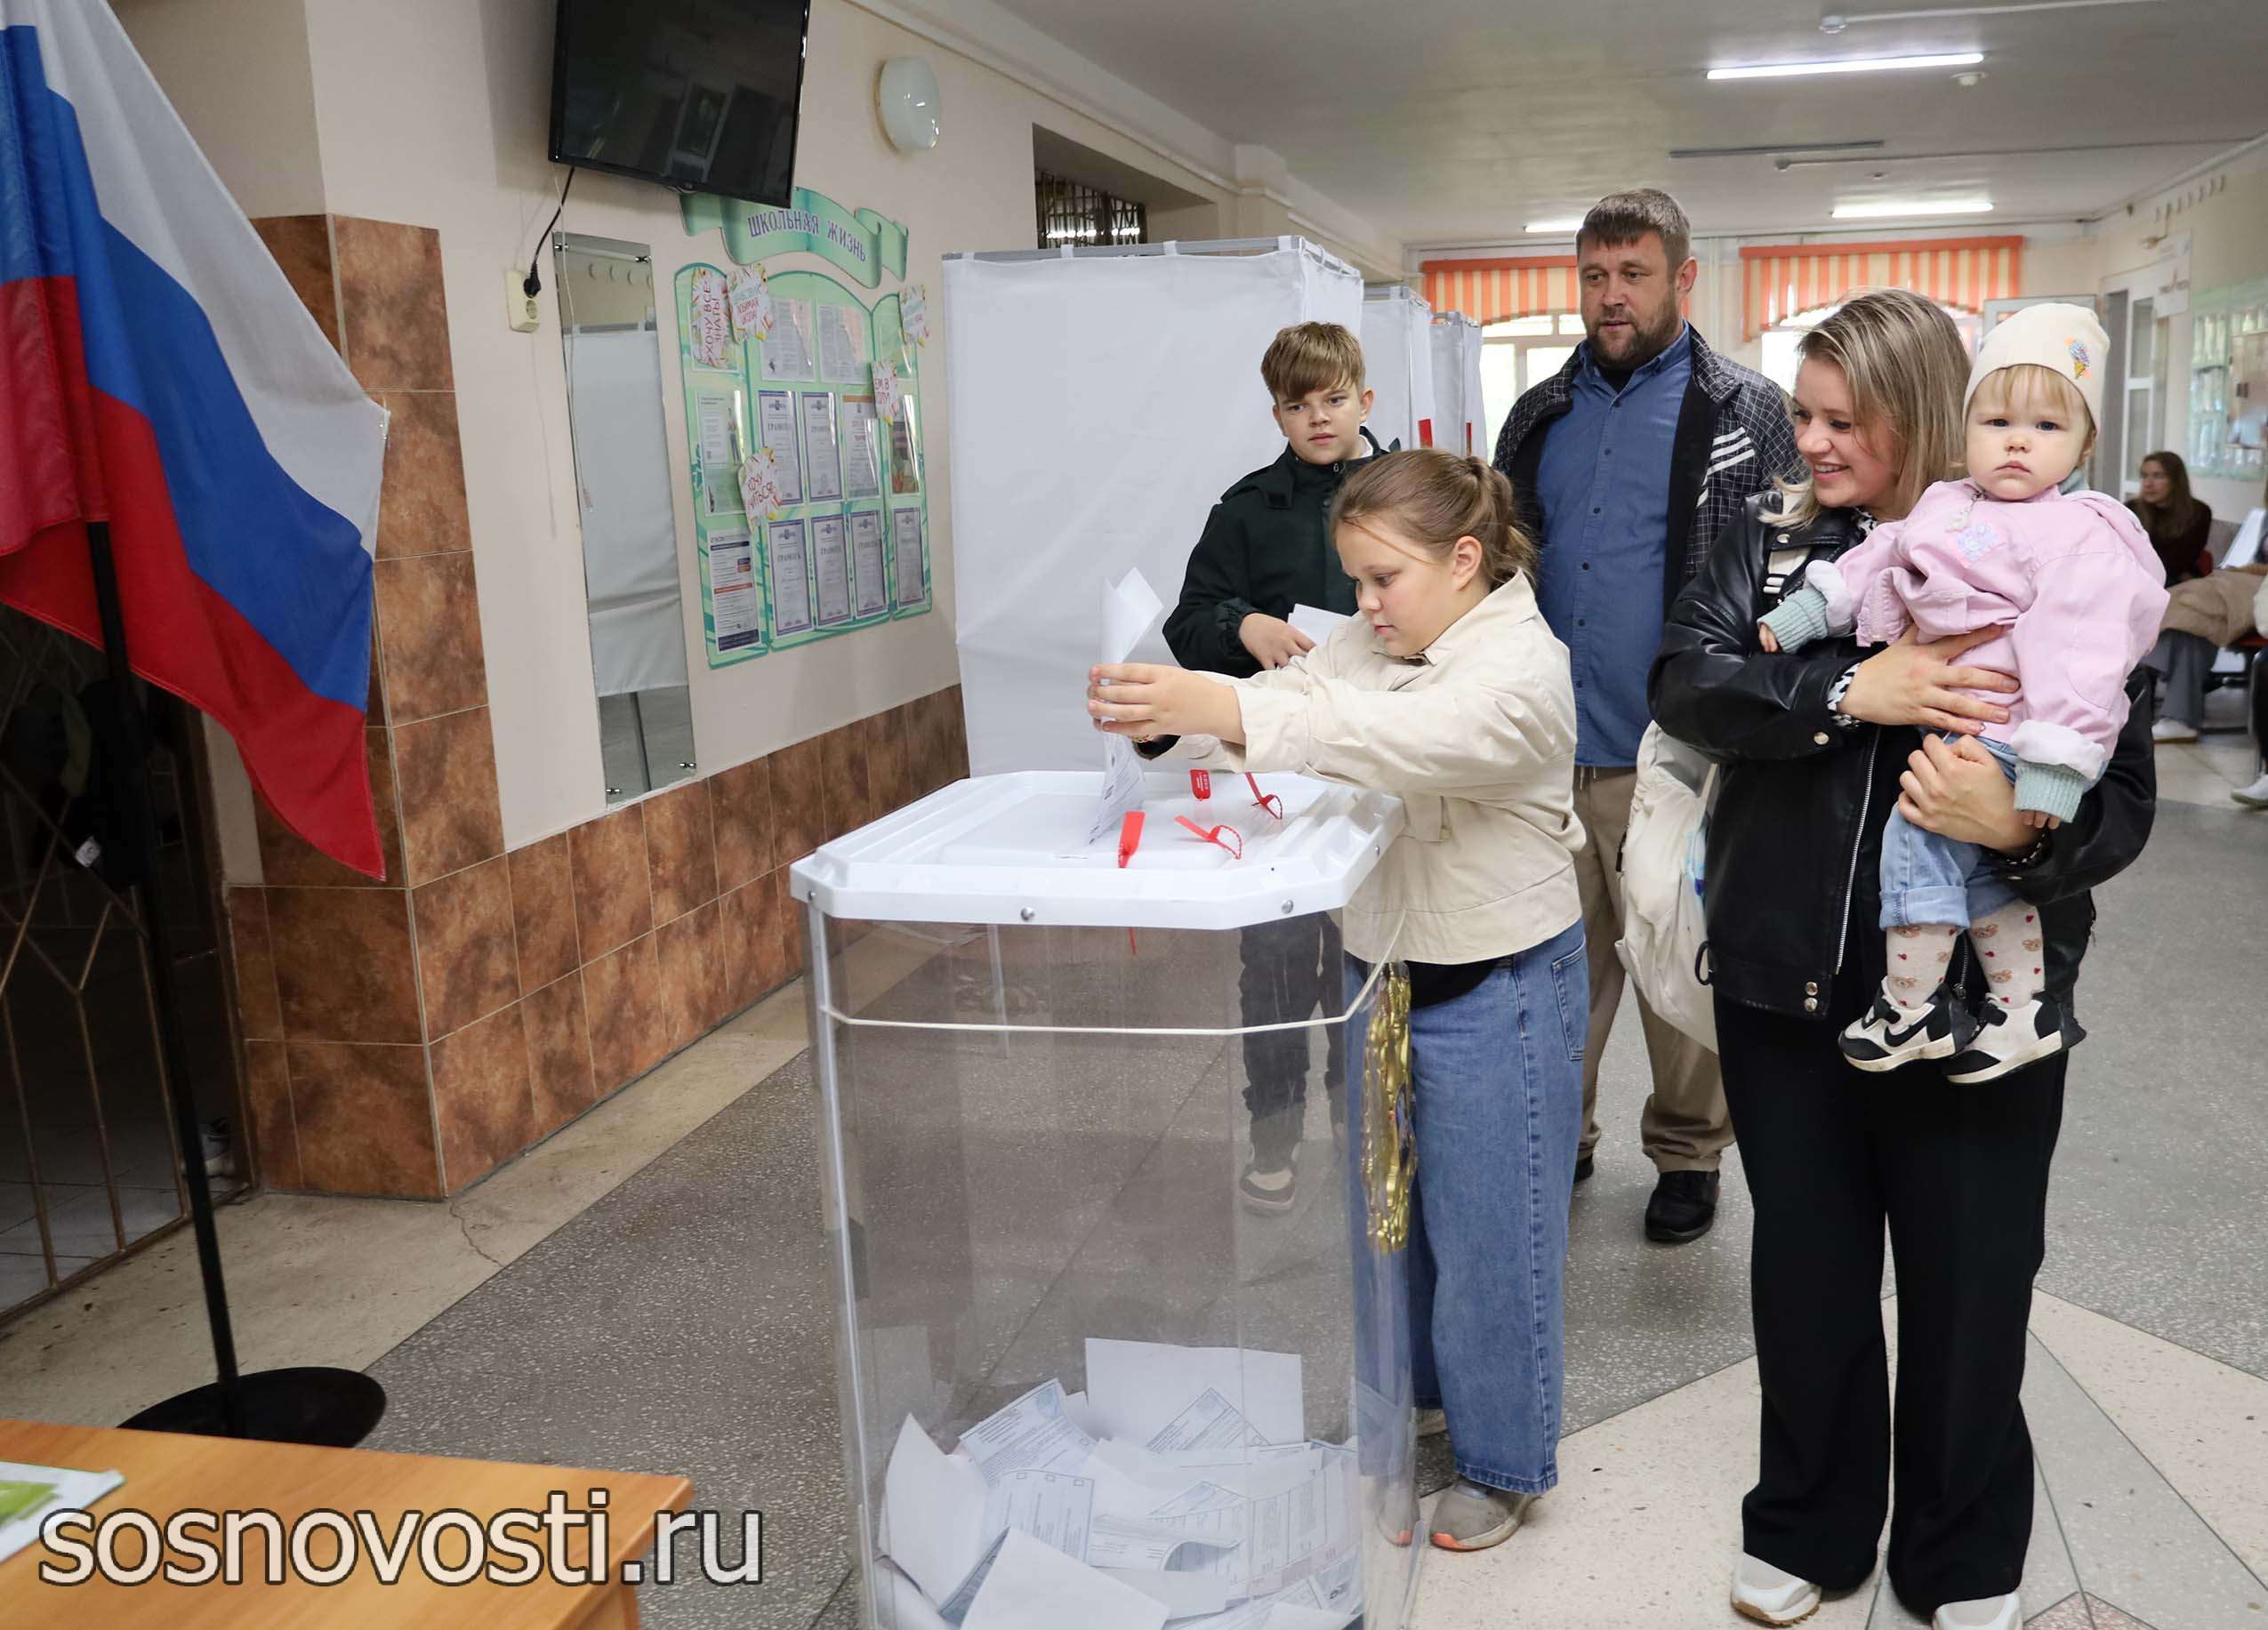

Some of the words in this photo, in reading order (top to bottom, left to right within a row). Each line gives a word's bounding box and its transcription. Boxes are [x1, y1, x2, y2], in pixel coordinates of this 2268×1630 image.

[747, 210, 819, 237] ШКОЛЬНАЯ
[826, 220, 866, 262] ЖИЗНЬ
[704, 317, 713, 356] ХОЧУ
